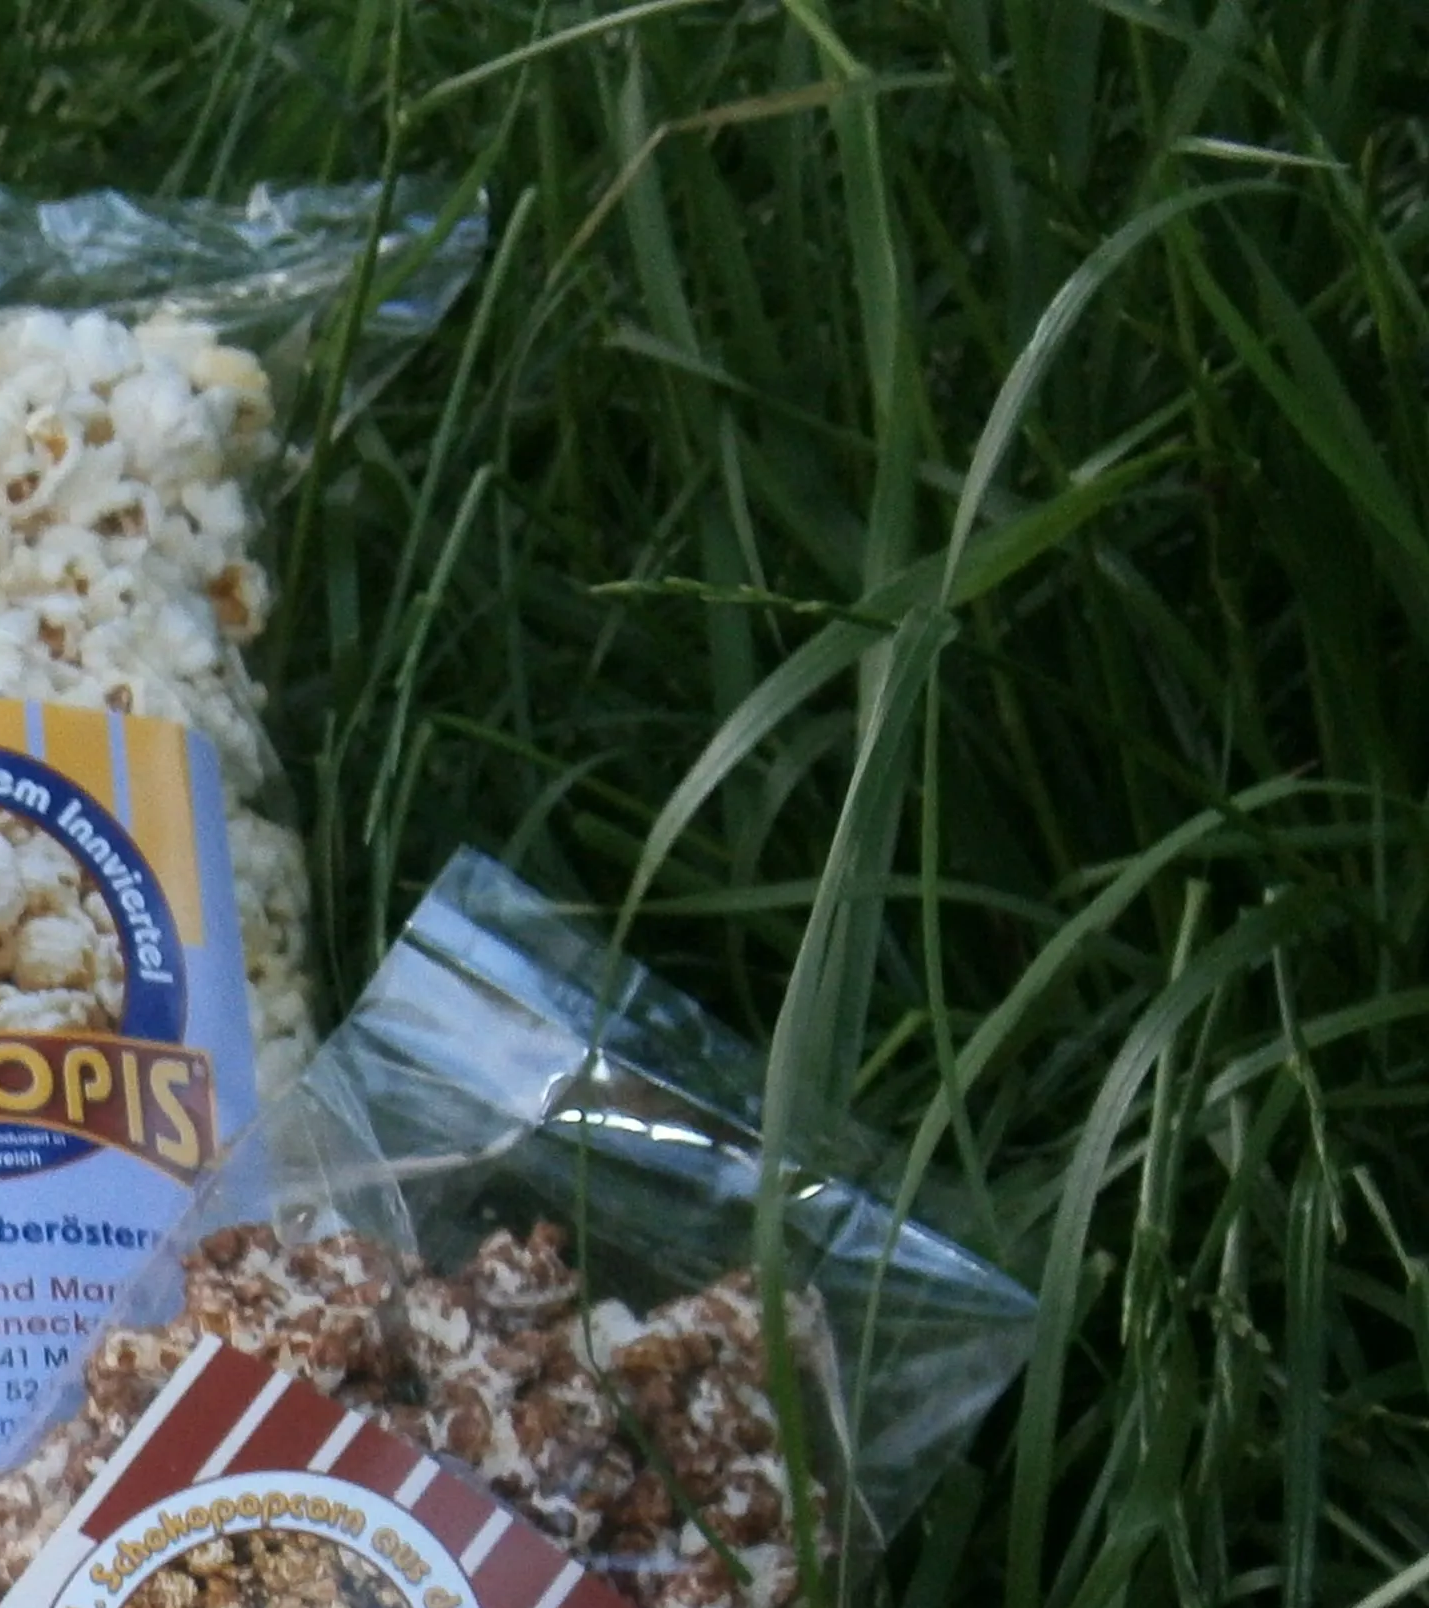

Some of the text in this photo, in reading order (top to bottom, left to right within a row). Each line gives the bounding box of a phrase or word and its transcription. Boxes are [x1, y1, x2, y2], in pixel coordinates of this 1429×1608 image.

[57, 799, 174, 985] Innviertel
[90, 1489, 366, 1591] Schokopopcorn
[371, 1524, 433, 1585] aus
